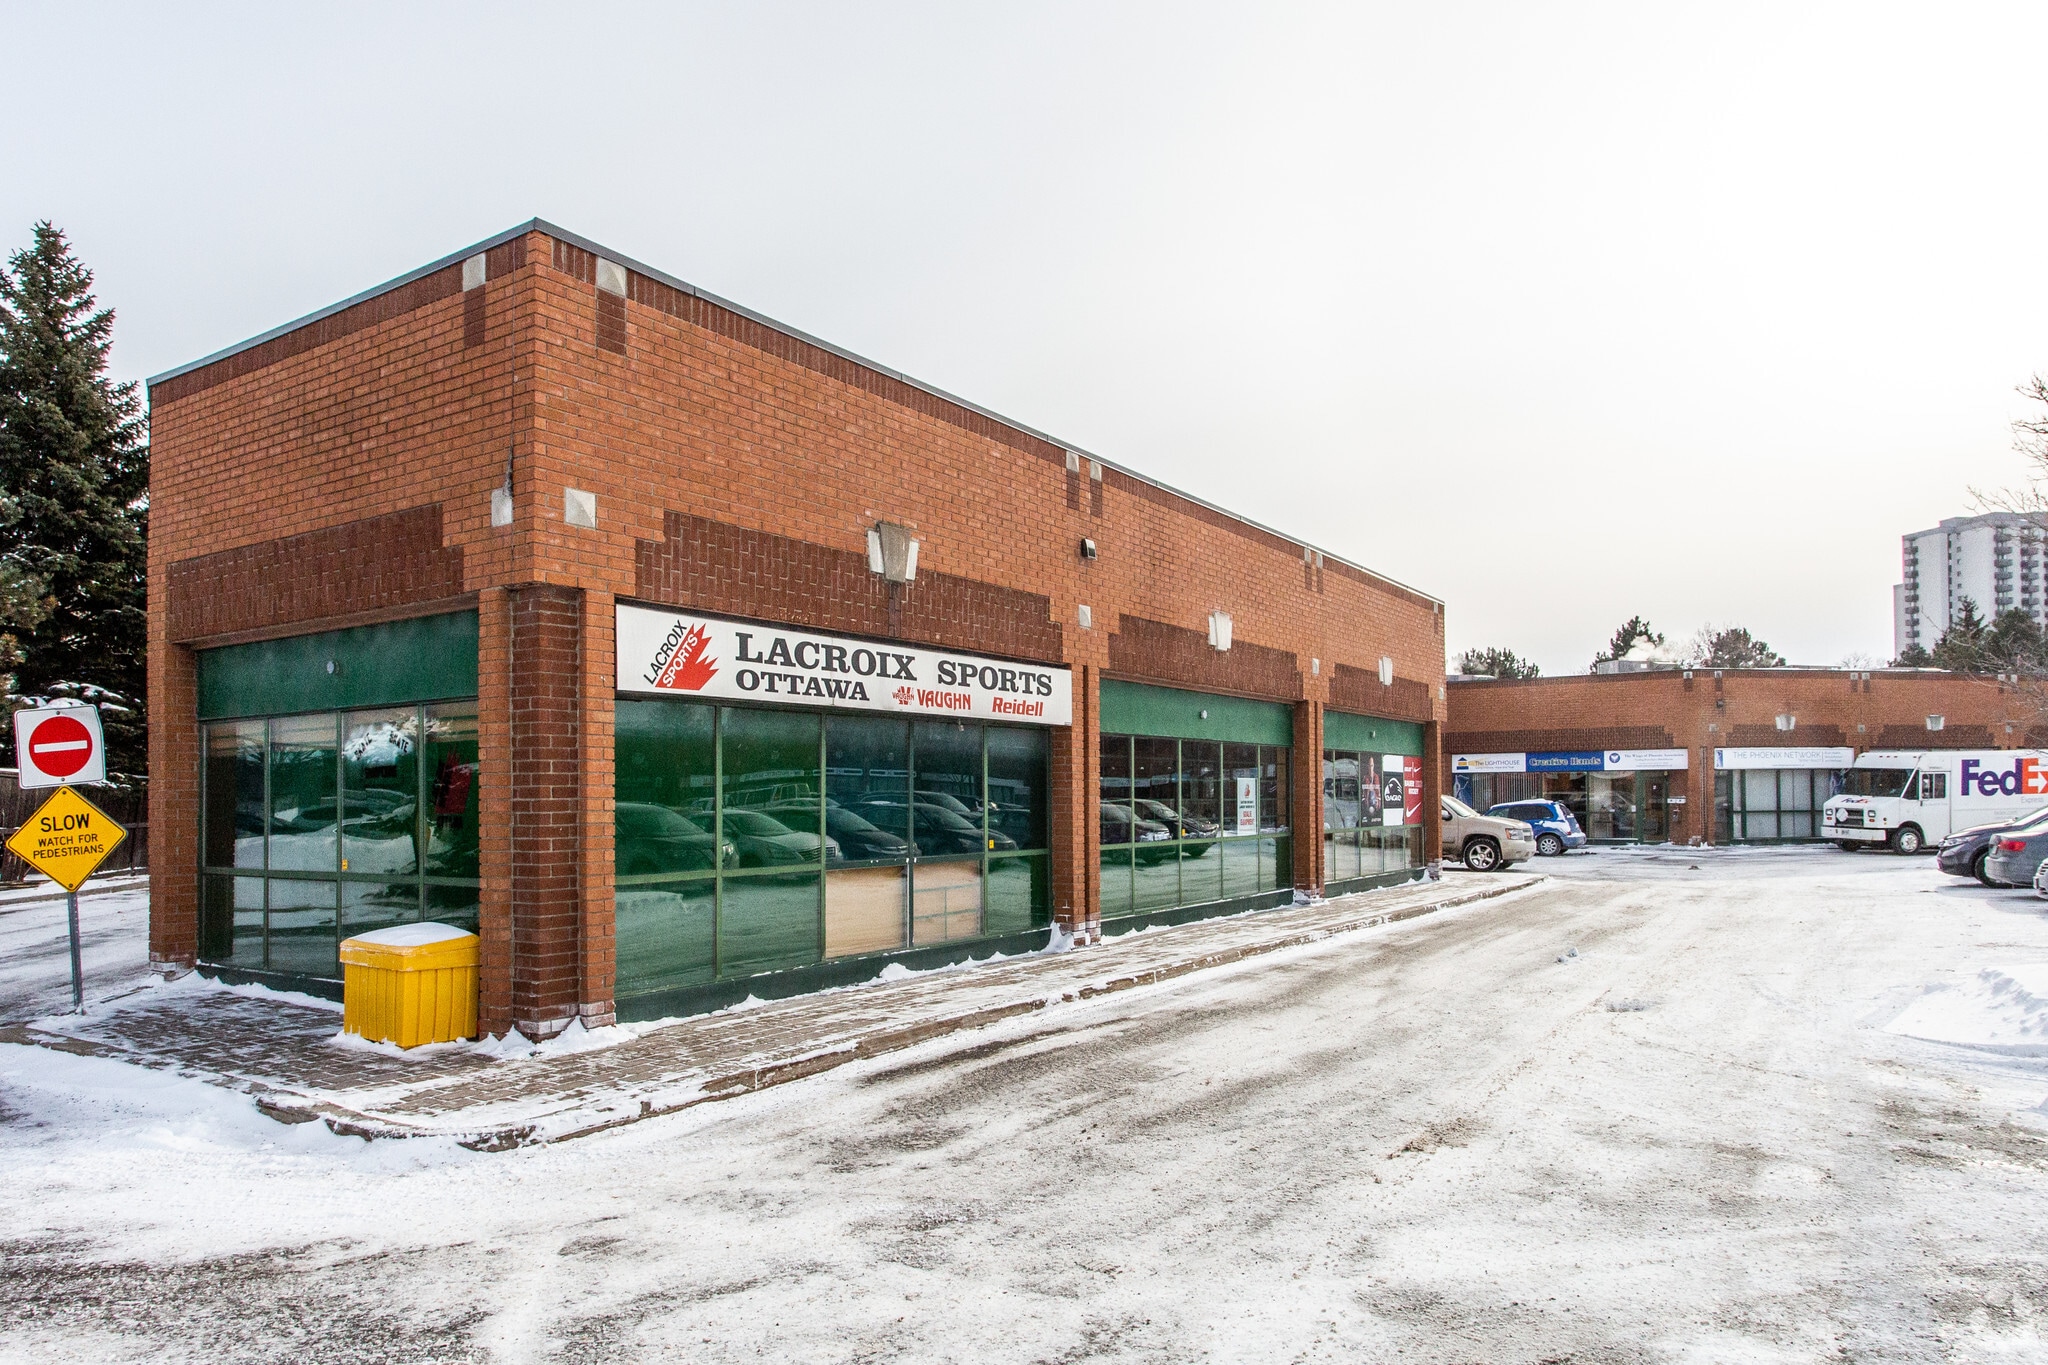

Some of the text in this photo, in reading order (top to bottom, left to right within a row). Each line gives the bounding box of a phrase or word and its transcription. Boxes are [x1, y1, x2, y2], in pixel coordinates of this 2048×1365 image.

[643, 619, 687, 685] LACROIX
[662, 634, 698, 687] SPORTS
[735, 632, 1053, 697] LACROIX SPORTS
[735, 669, 870, 701] OTTAWA
[917, 688, 971, 711] VAUGHN
[992, 697, 1044, 717] Reidell
[1529, 756, 1601, 767] Creative Hands
[1733, 751, 1820, 759] THE PHOENIX NETWORK
[40, 813, 90, 832] SLOW
[38, 833, 98, 848] WATCH FOR
[33, 844, 104, 859] PEDESTRIANS
